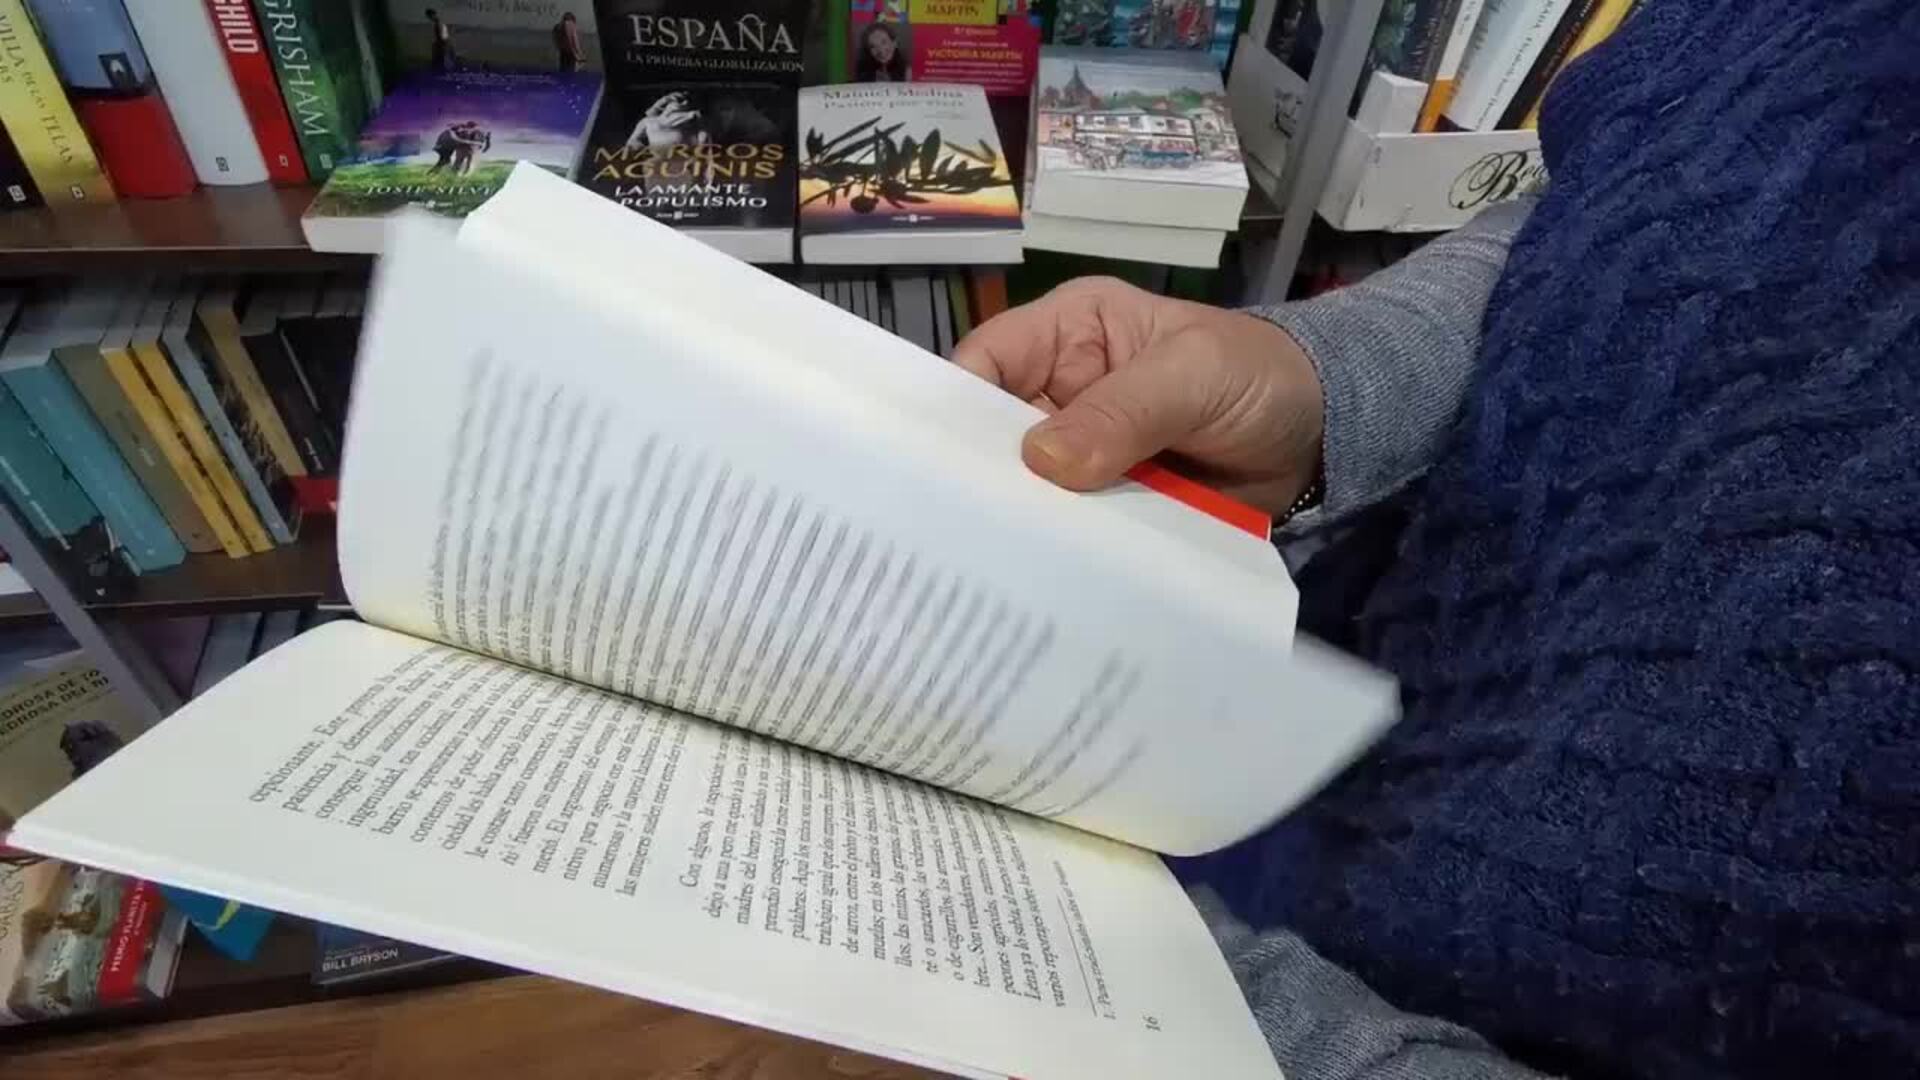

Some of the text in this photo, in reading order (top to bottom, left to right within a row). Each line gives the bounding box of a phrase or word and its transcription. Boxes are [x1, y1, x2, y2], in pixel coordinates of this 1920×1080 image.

[627, 13, 799, 54] ESPAÑA
[594, 142, 785, 162] MARCOS
[592, 160, 777, 179] AGUINIS
[615, 182, 752, 197] LA AMANTE
[322, 959, 347, 973] BILL
[350, 947, 399, 967] BRYSON
[1142, 1015, 1162, 1032] 16
